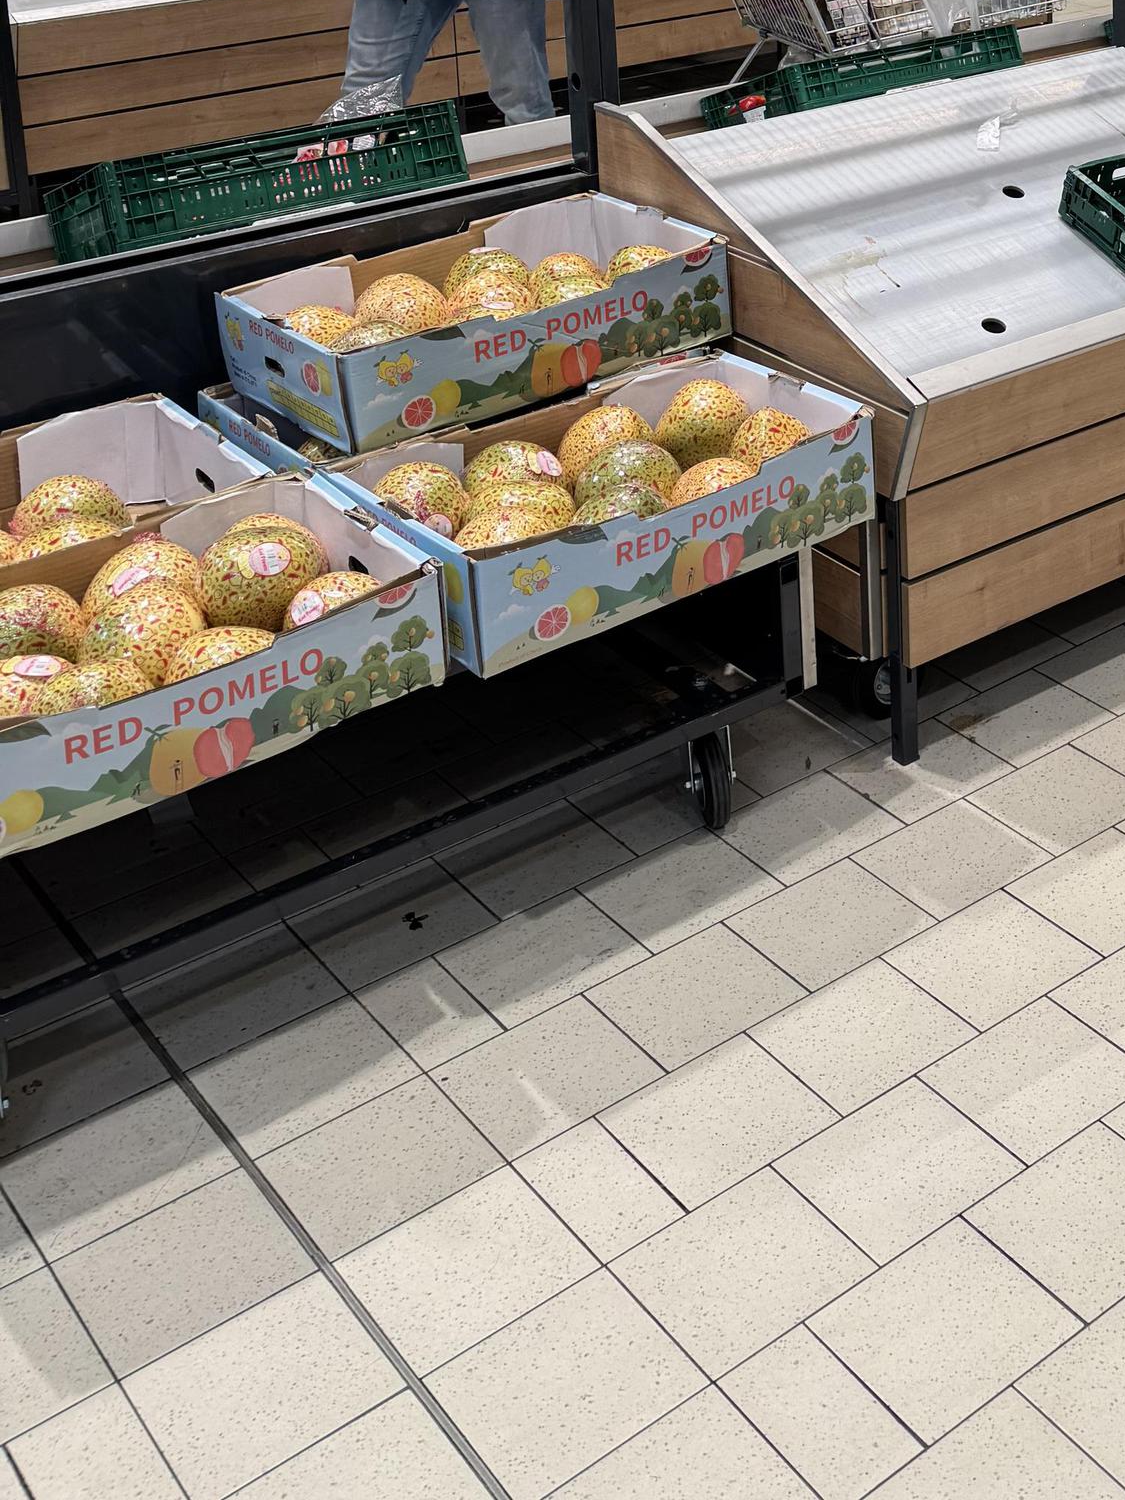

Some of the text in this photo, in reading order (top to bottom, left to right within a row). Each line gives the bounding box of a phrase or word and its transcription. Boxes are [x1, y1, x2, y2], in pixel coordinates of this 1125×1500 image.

[248, 319, 295, 355] RED POMELO
[474, 290, 649, 363] RED POMELO
[616, 475, 796, 567] RED POMELO
[64, 648, 324, 765] RED POMELO
